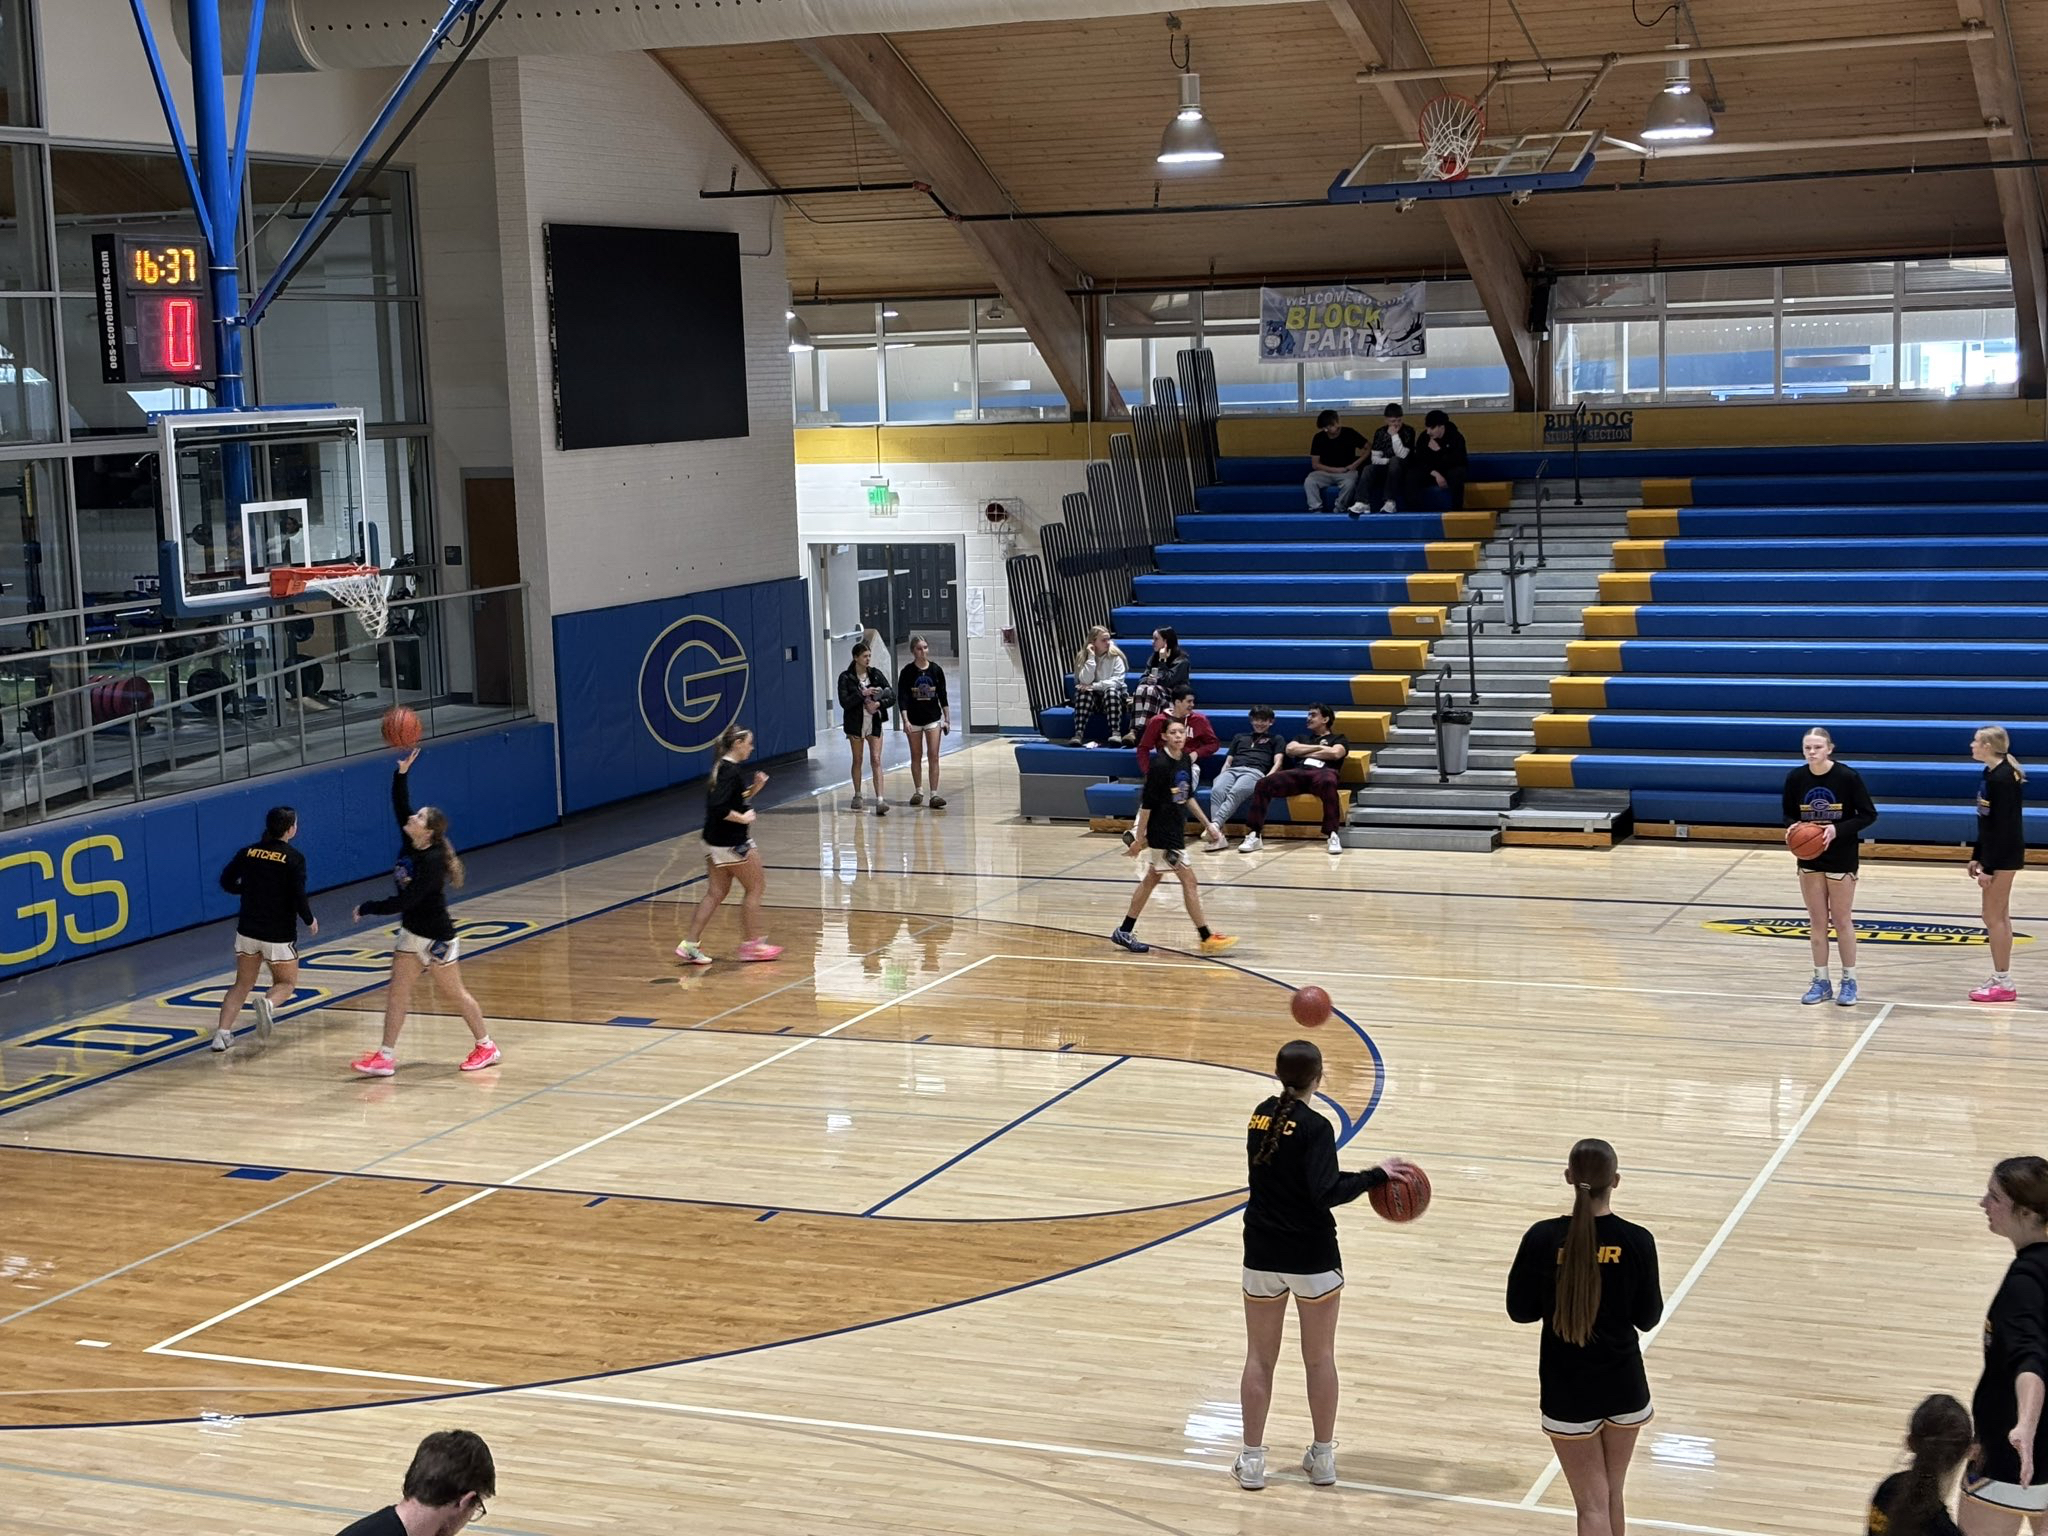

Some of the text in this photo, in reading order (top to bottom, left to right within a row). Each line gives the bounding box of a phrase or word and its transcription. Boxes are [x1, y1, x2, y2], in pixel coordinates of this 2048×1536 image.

[135, 248, 195, 284] 16:37
[1286, 290, 1353, 306] WELCOME
[1286, 303, 1382, 330] BLOCK
[168, 301, 192, 367] 0
[246, 848, 287, 864] MITCHELL
[1749, 919, 1880, 930] COANIES
[1901, 924, 1984, 935] FAMILY
[1730, 926, 1990, 943] HOLLDAY
